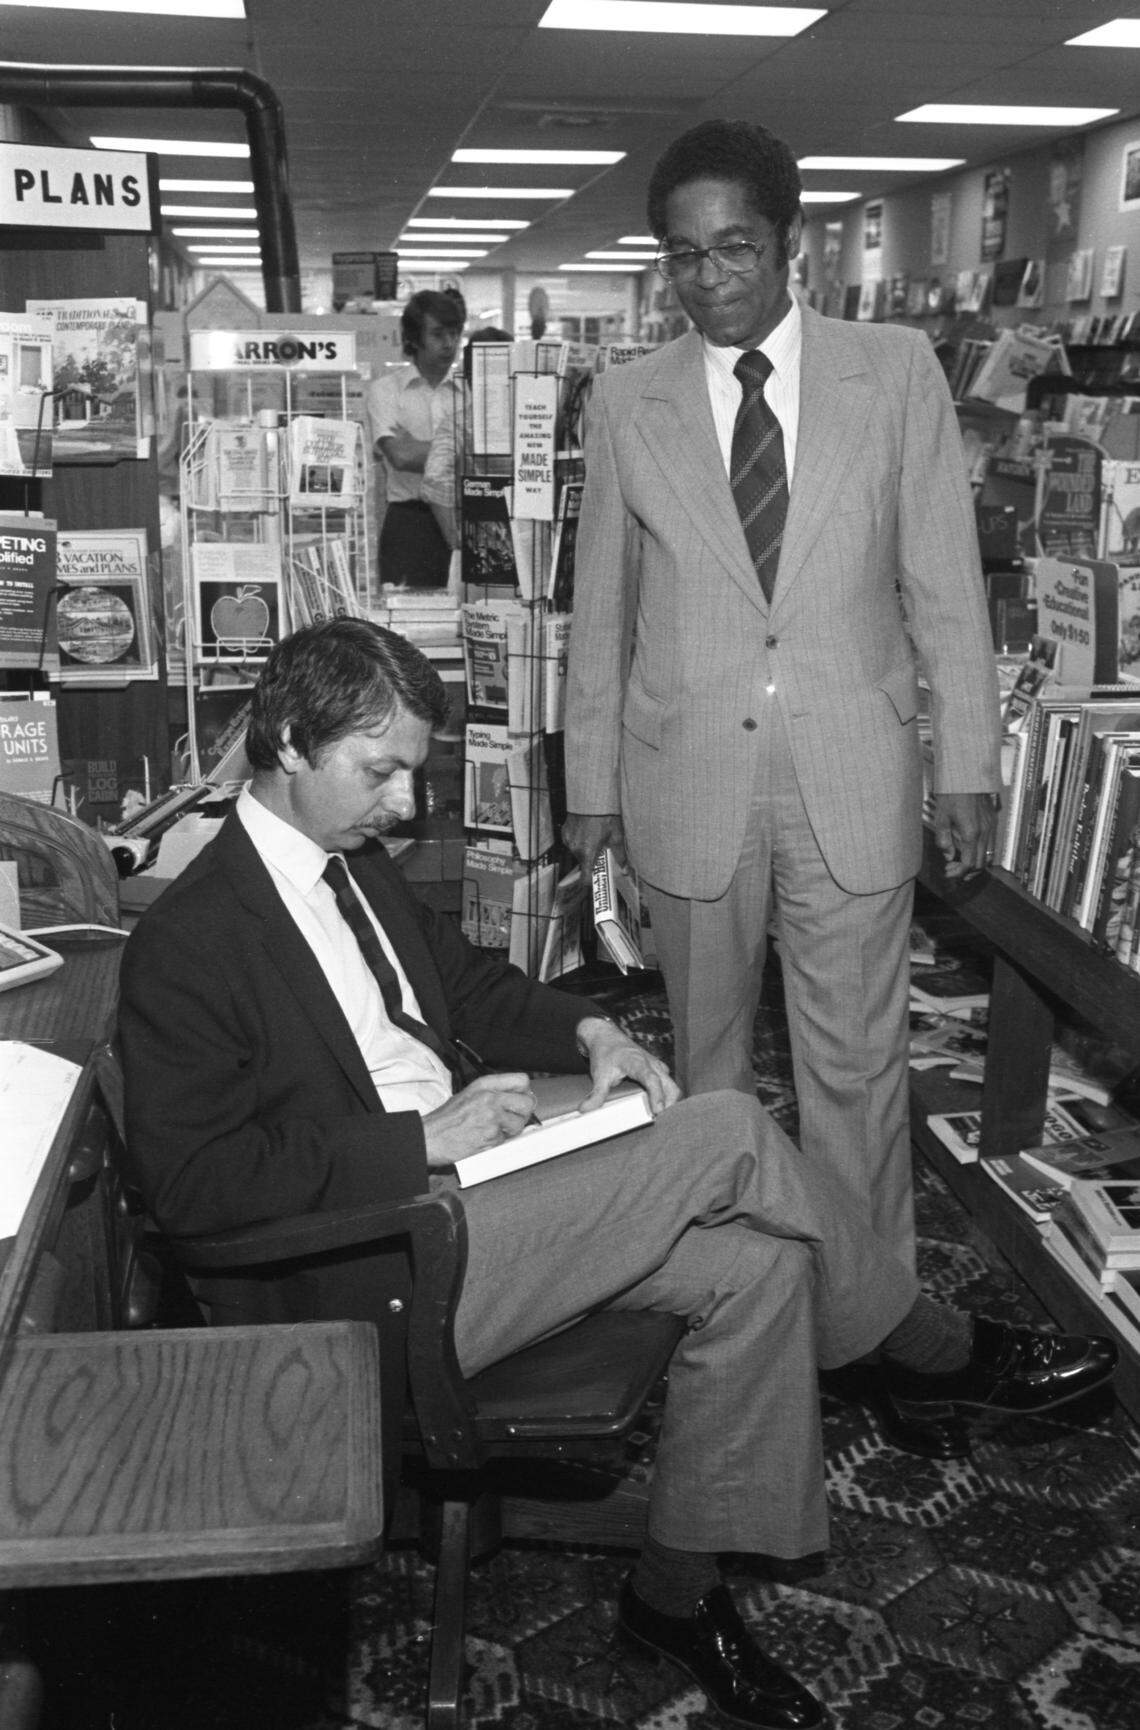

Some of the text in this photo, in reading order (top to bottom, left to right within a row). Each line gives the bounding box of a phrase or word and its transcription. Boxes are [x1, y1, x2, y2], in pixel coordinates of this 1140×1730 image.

[14, 168, 141, 207] PLANS
[521, 452, 549, 467] MADE
[518, 468, 552, 483] SIMPLE
[0, 535, 47, 552] ETING
[64, 552, 123, 563] VACATION
[100, 562, 138, 574] PLANS
[468, 729, 491, 741] Typing
[3, 739, 48, 755] UNITS
[468, 738, 513, 751] Made Simple
[88, 777, 118, 790] LOG
